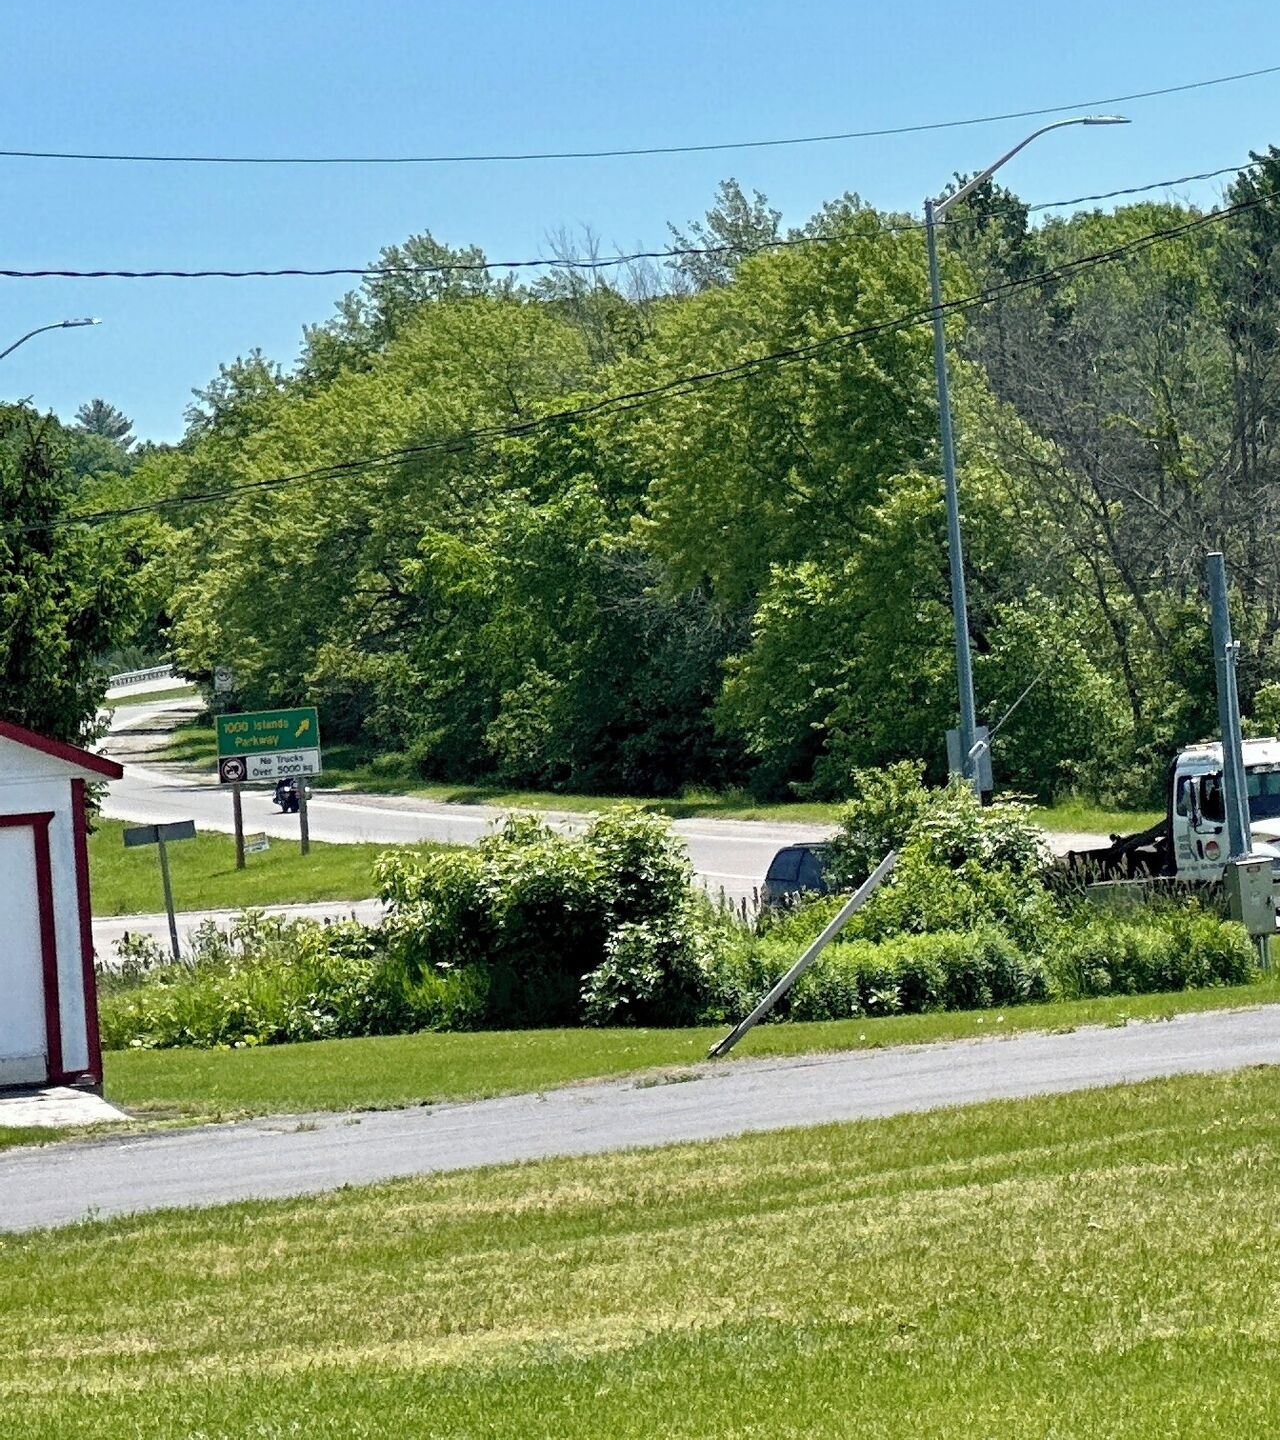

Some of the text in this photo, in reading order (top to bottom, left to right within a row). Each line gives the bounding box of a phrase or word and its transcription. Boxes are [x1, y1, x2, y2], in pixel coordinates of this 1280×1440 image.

[224, 719, 289, 734] 1000 Islands
[235, 735, 279, 747] Parkway
[260, 755, 303, 765] No Trucks
[252, 768, 272, 776] Over
[277, 765, 301, 774] 5000
